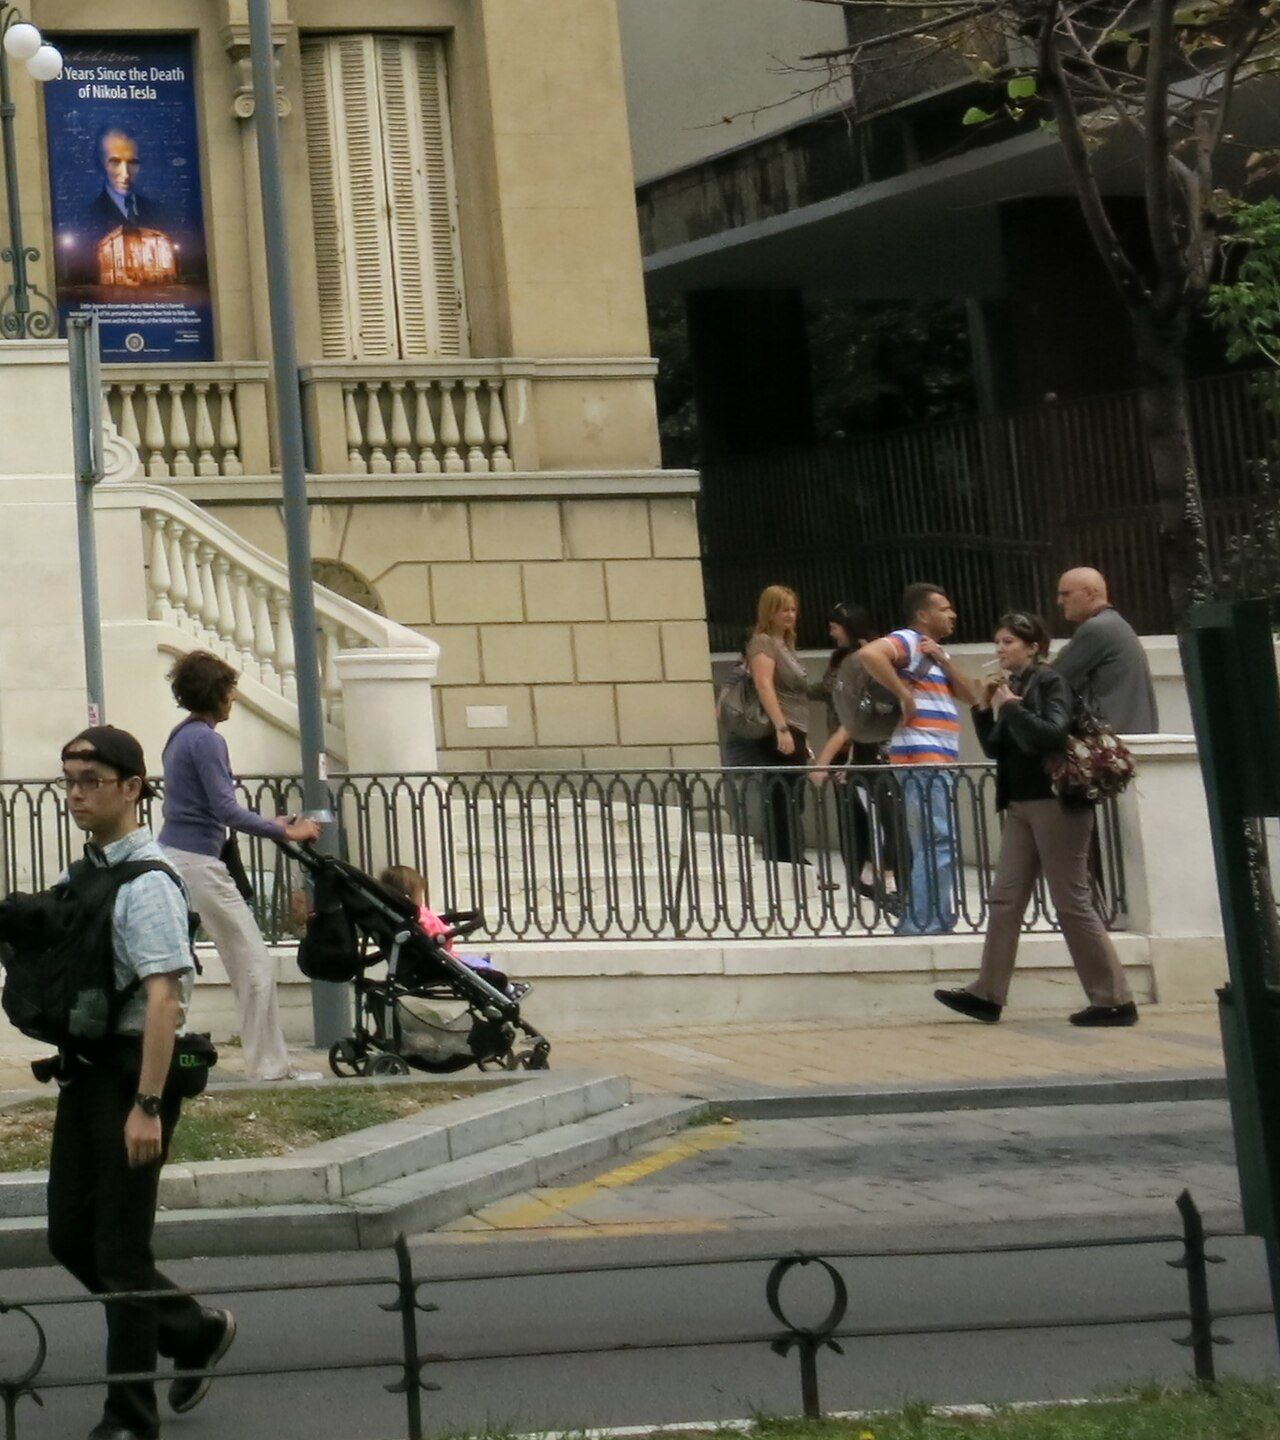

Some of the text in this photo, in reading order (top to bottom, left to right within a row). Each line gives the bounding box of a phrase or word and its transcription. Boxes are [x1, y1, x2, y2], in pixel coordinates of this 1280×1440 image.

[64, 67, 94, 80] Years
[96, 66, 126, 81] Since
[128, 67, 148, 81] the
[150, 67, 185, 82] Death
[78, 84, 157, 100] of Nikola Tesla
